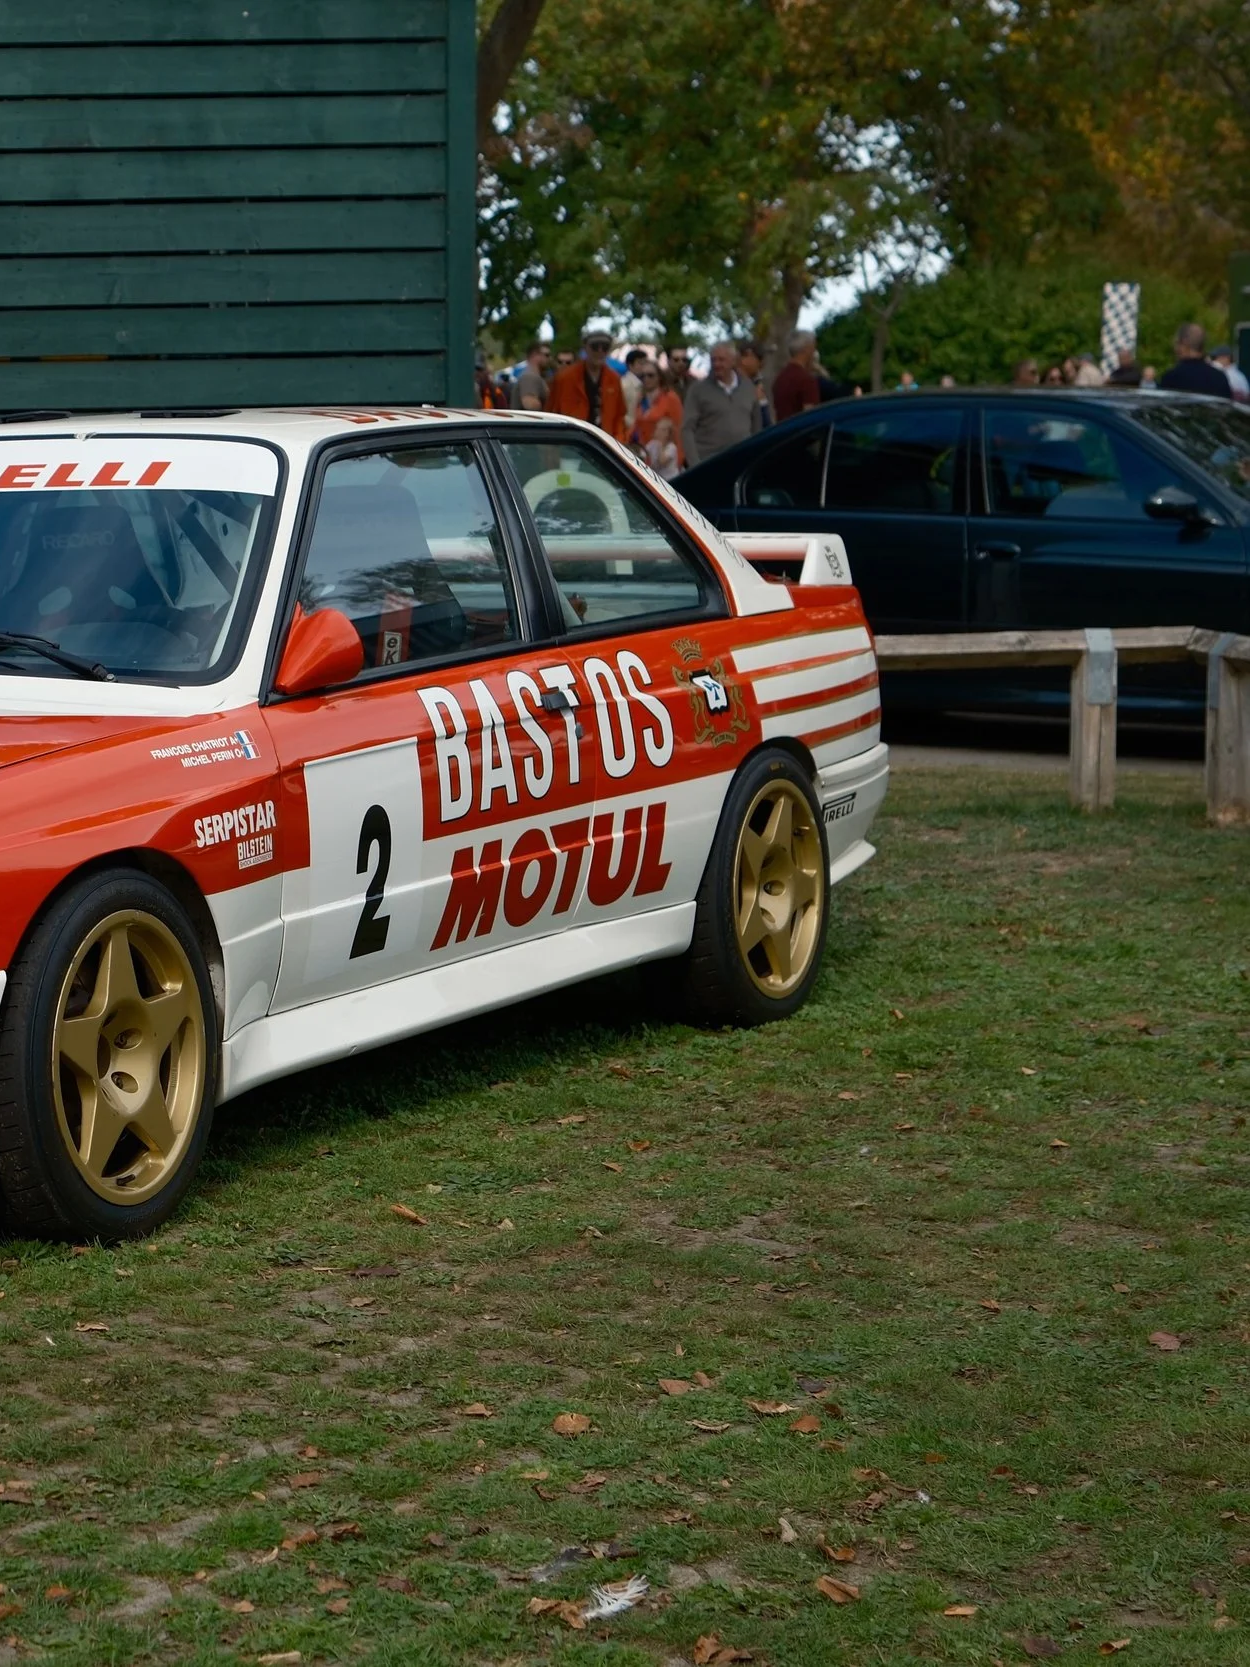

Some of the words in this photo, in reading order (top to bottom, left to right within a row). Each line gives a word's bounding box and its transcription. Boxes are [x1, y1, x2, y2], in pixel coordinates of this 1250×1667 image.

[191, 737, 229, 753] CHATRIOT
[415, 650, 674, 823] BASTOS
[181, 754, 211, 768] MICHEL
[212, 750, 234, 763] PERIN
[194, 800, 276, 848] SERPISTAR
[823, 792, 857, 823] PIRELLI
[237, 833, 273, 860] BILSTEIN
[350, 804, 392, 959] 2
[431, 802, 672, 951] MOTUL
